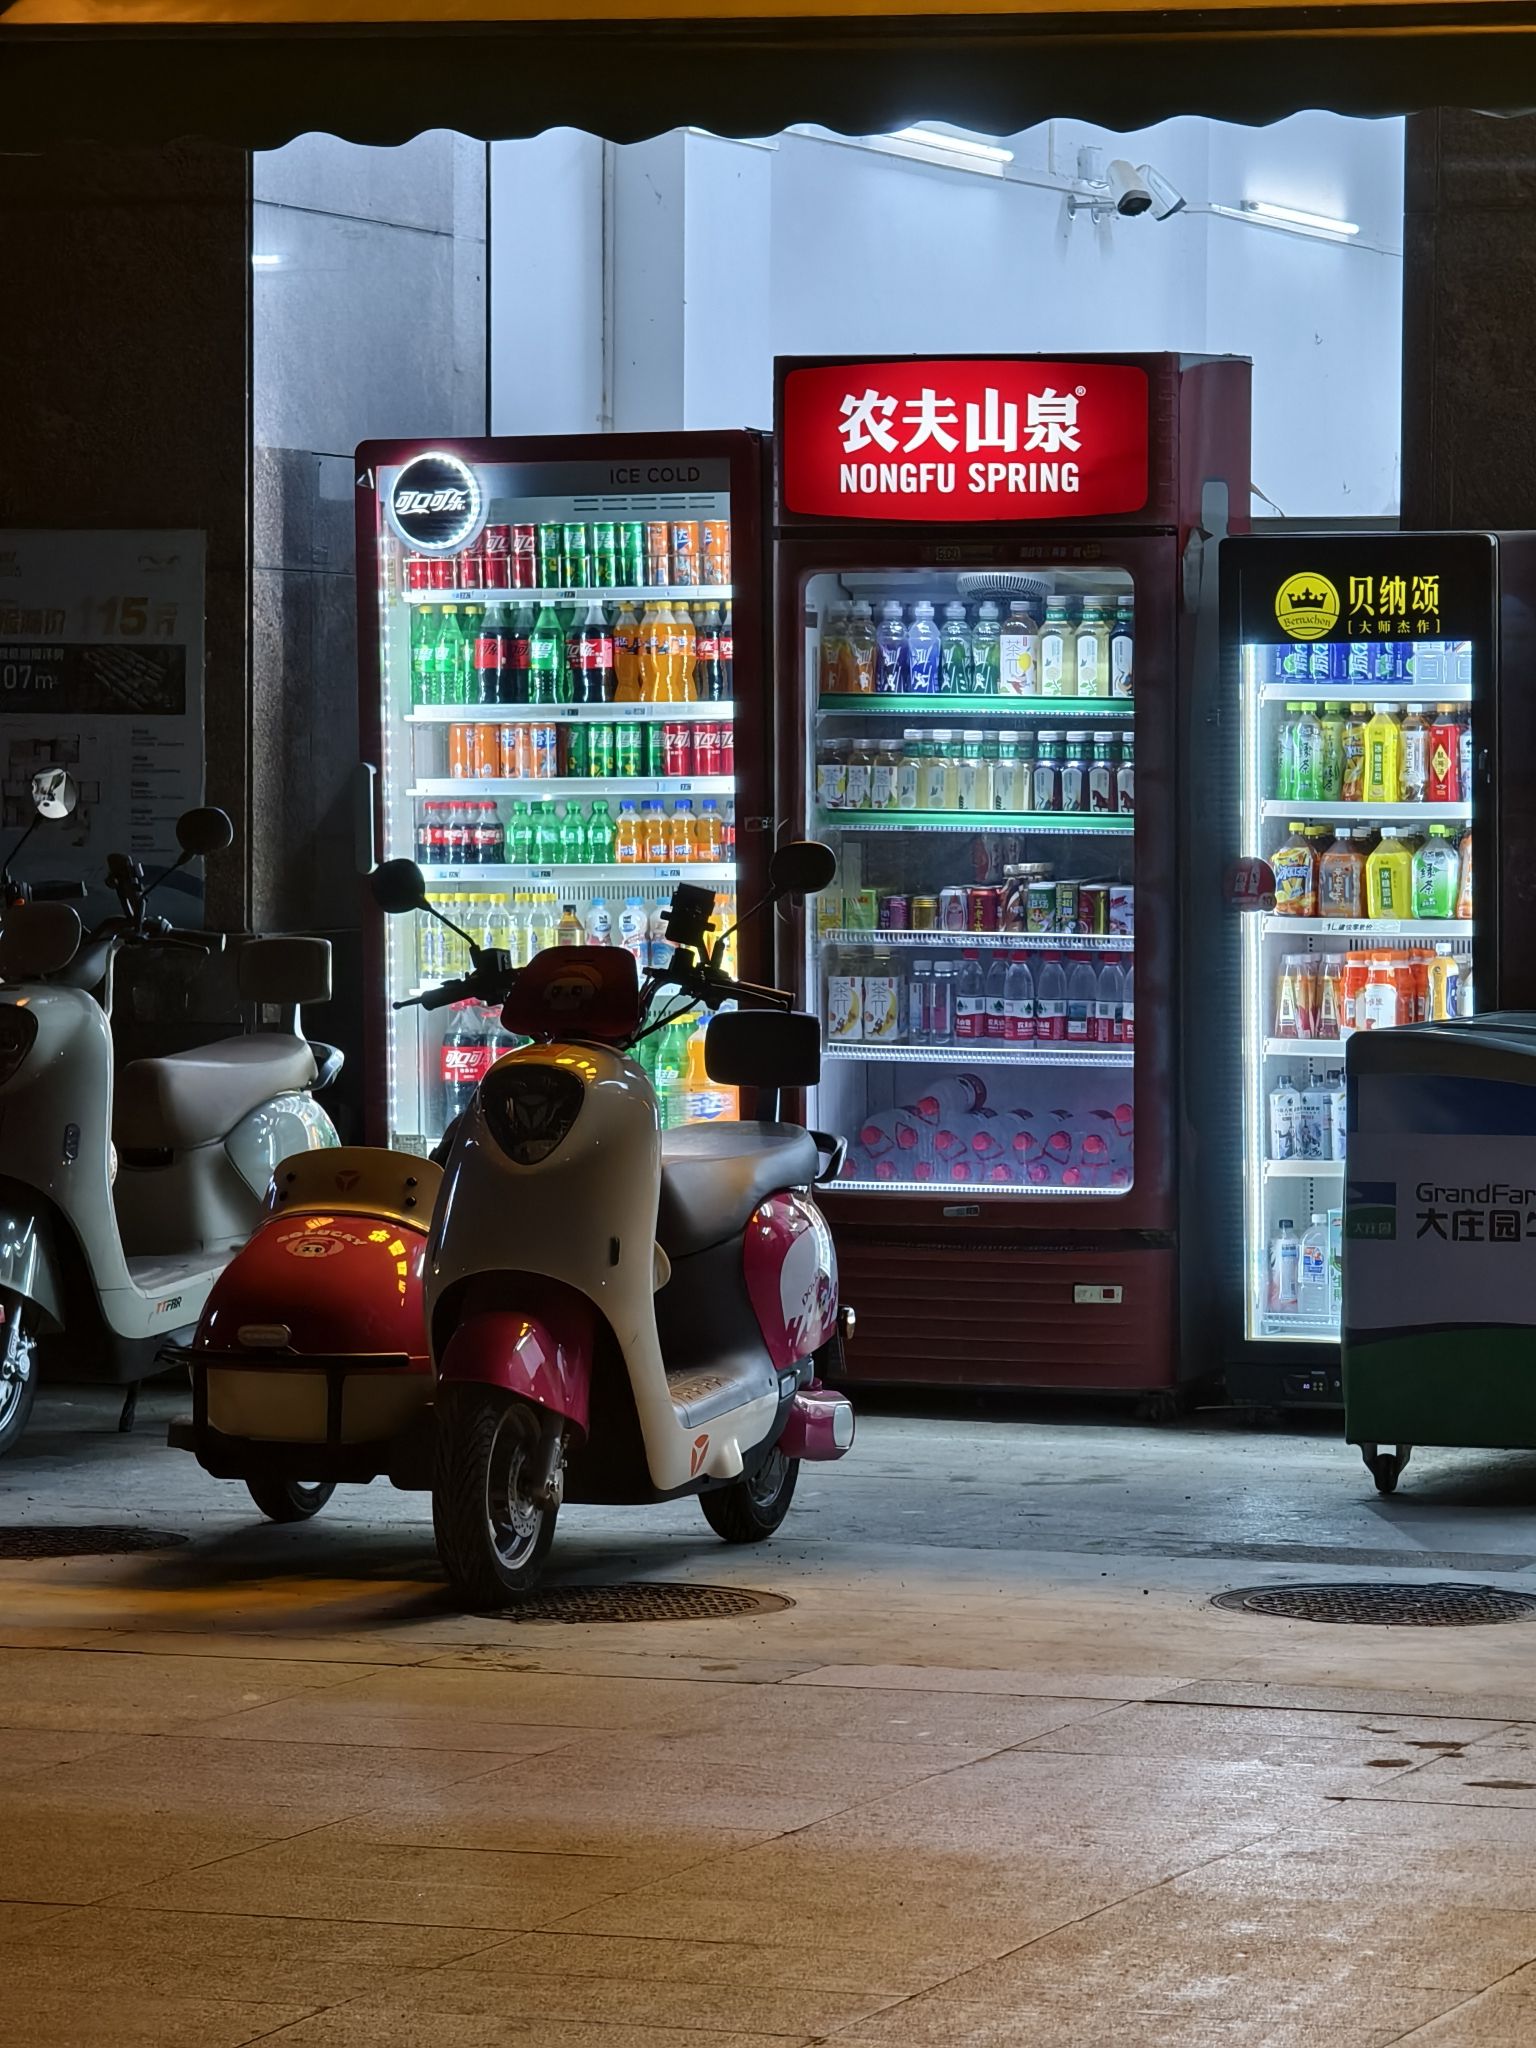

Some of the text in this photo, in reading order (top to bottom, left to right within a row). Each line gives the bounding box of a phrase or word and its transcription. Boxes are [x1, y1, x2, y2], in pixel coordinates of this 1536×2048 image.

[838, 387, 1082, 454] 农夫山泉
[609, 466, 700, 484] ICE COLD
[840, 462, 1080, 493] NONGFU SPRING
[395, 487, 470, 515] 可口可乐
[1349, 575, 1440, 617] 贝纳颂
[1283, 614, 1332, 628] Bernachon
